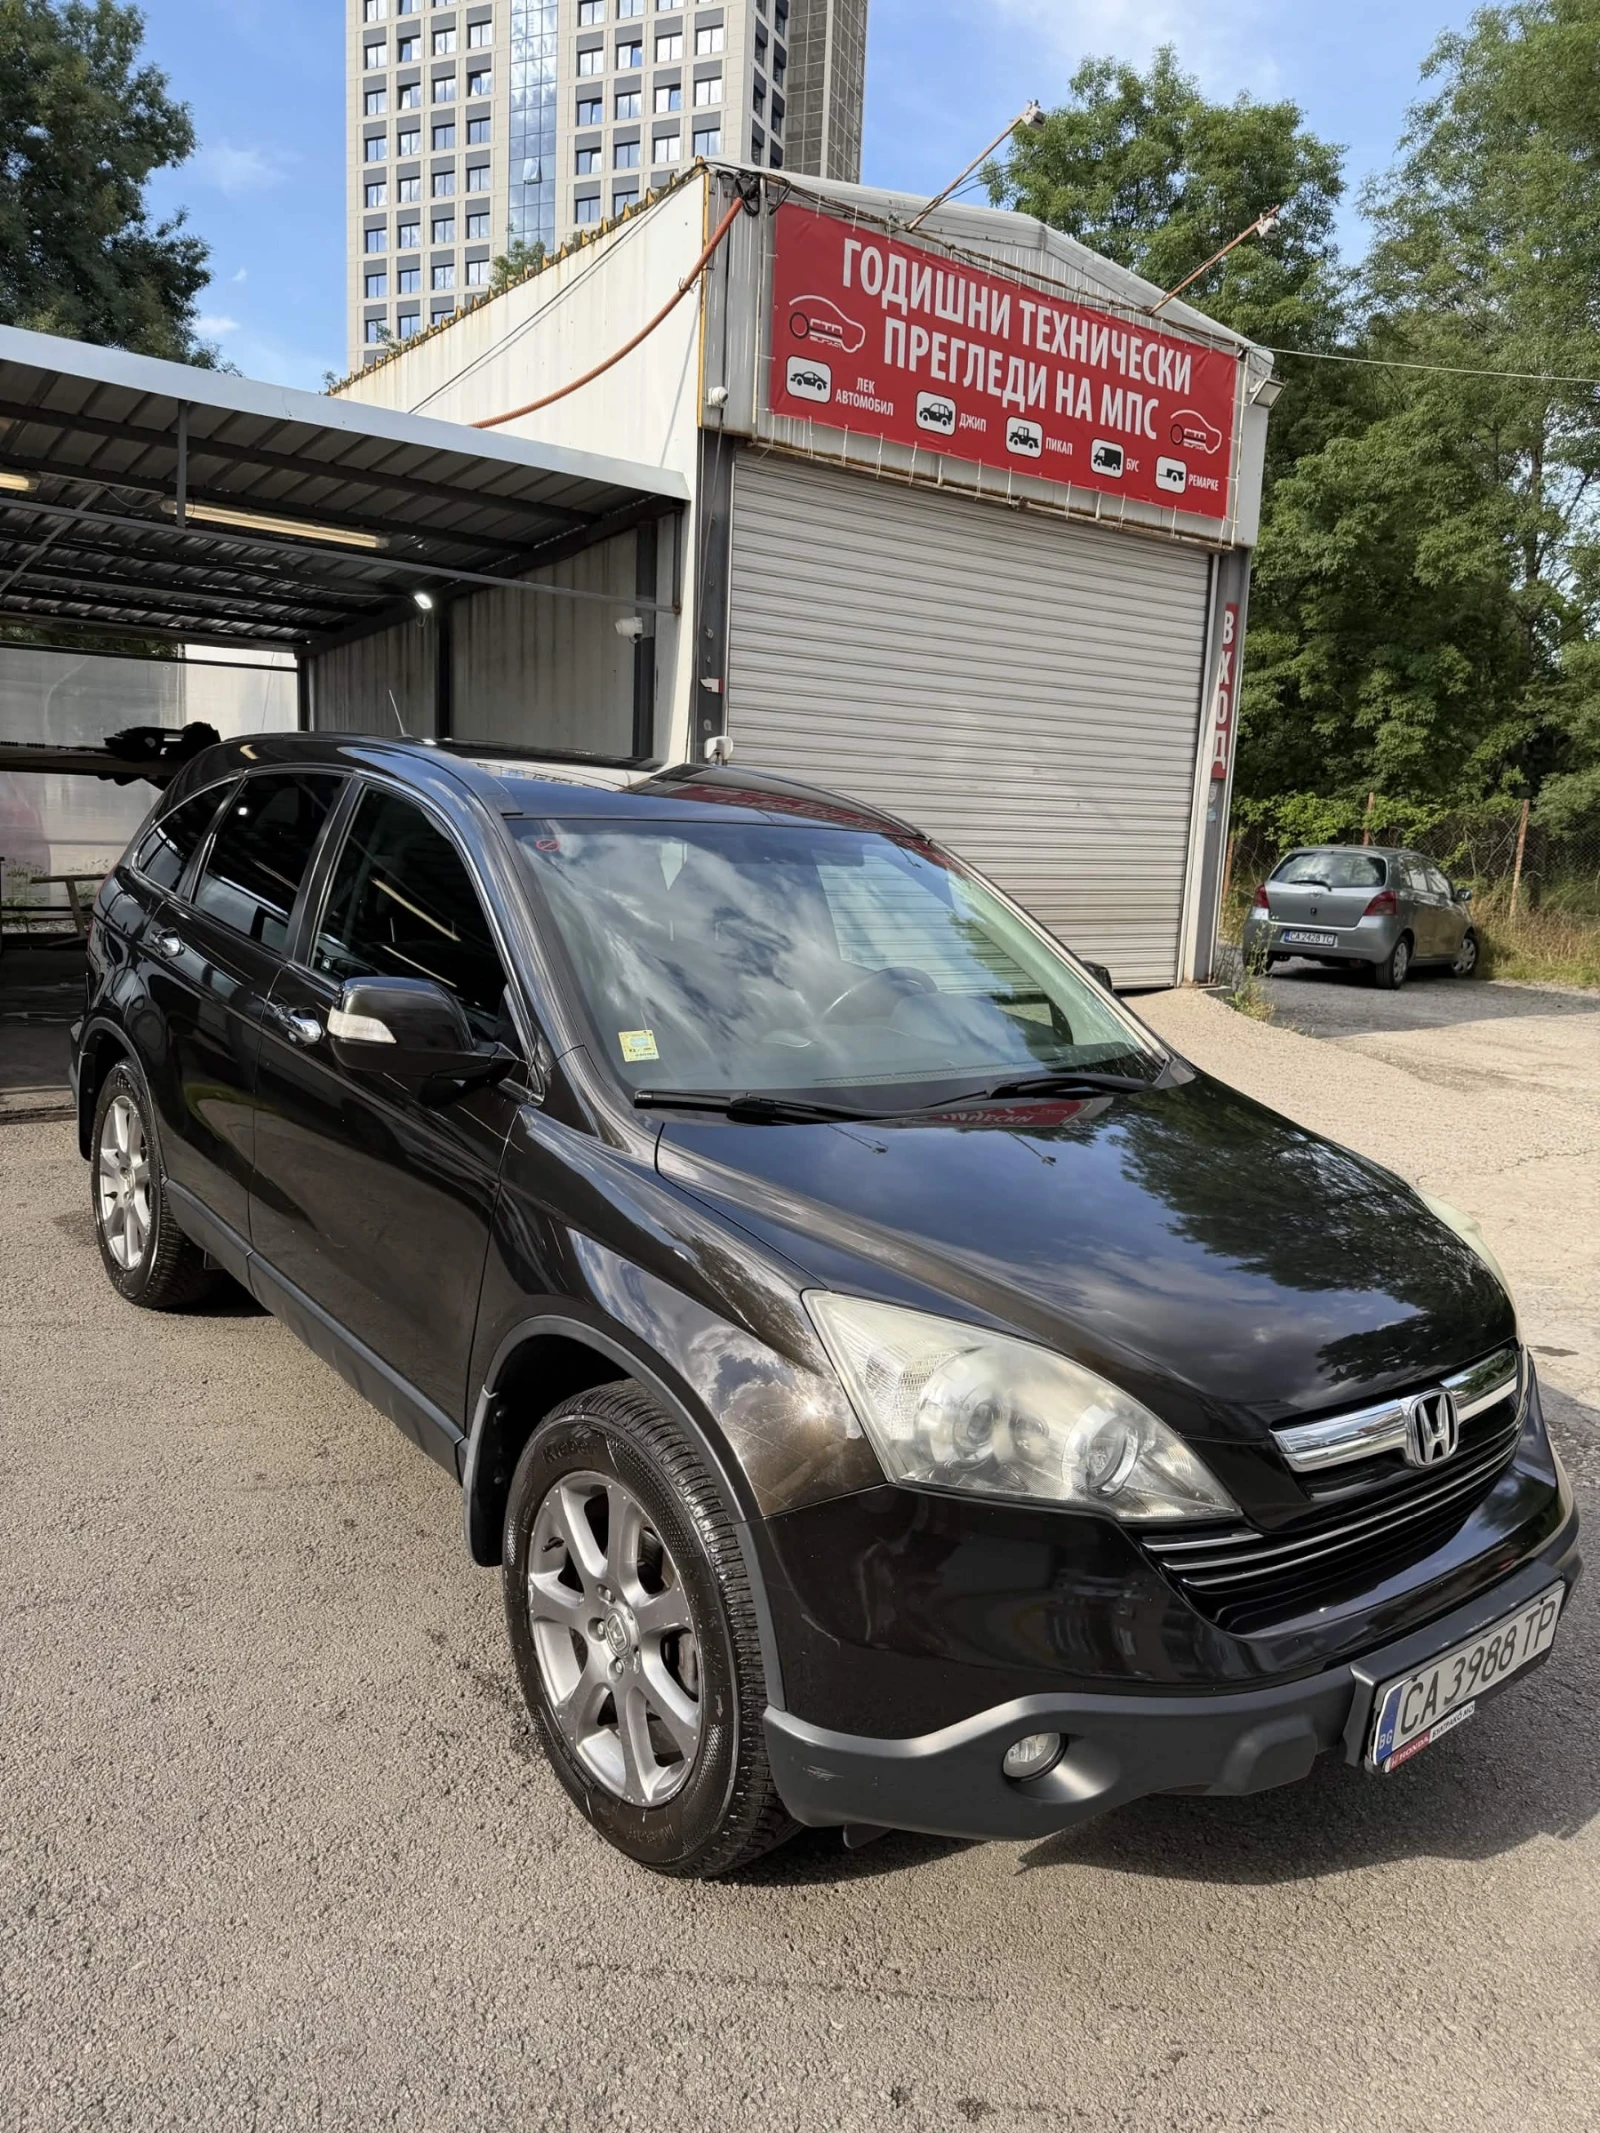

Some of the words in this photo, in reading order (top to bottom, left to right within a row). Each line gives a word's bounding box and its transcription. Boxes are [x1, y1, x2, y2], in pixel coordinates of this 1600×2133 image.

[843, 238, 1011, 339] ГОДИШНИ
[1019, 299, 1192, 395] ТЕХНИЧЕСКИ
[856, 377, 876, 394] ЛЕК
[884, 316, 1048, 413] ПРЕГЛЕДИ
[1055, 370, 1093, 422] НА
[1100, 384, 1159, 440] МПС
[835, 389, 894, 416] АВТОМОБИЛ
[959, 412, 987, 432] ДЖИП
[1045, 437, 1073, 456] ПИКАП
[1126, 458, 1140, 473] БУС
[1188, 474, 1219, 492] РЕМАРКЕ
[1212, 610, 1235, 770] ВХОД
[1400, 1670, 1440, 1736] CA
[1444, 1625, 1517, 1707] 3988
[1522, 1600, 1556, 1657] TP
[1378, 1730, 1393, 1750] BG
[1400, 1736, 1429, 1761] HONDA
